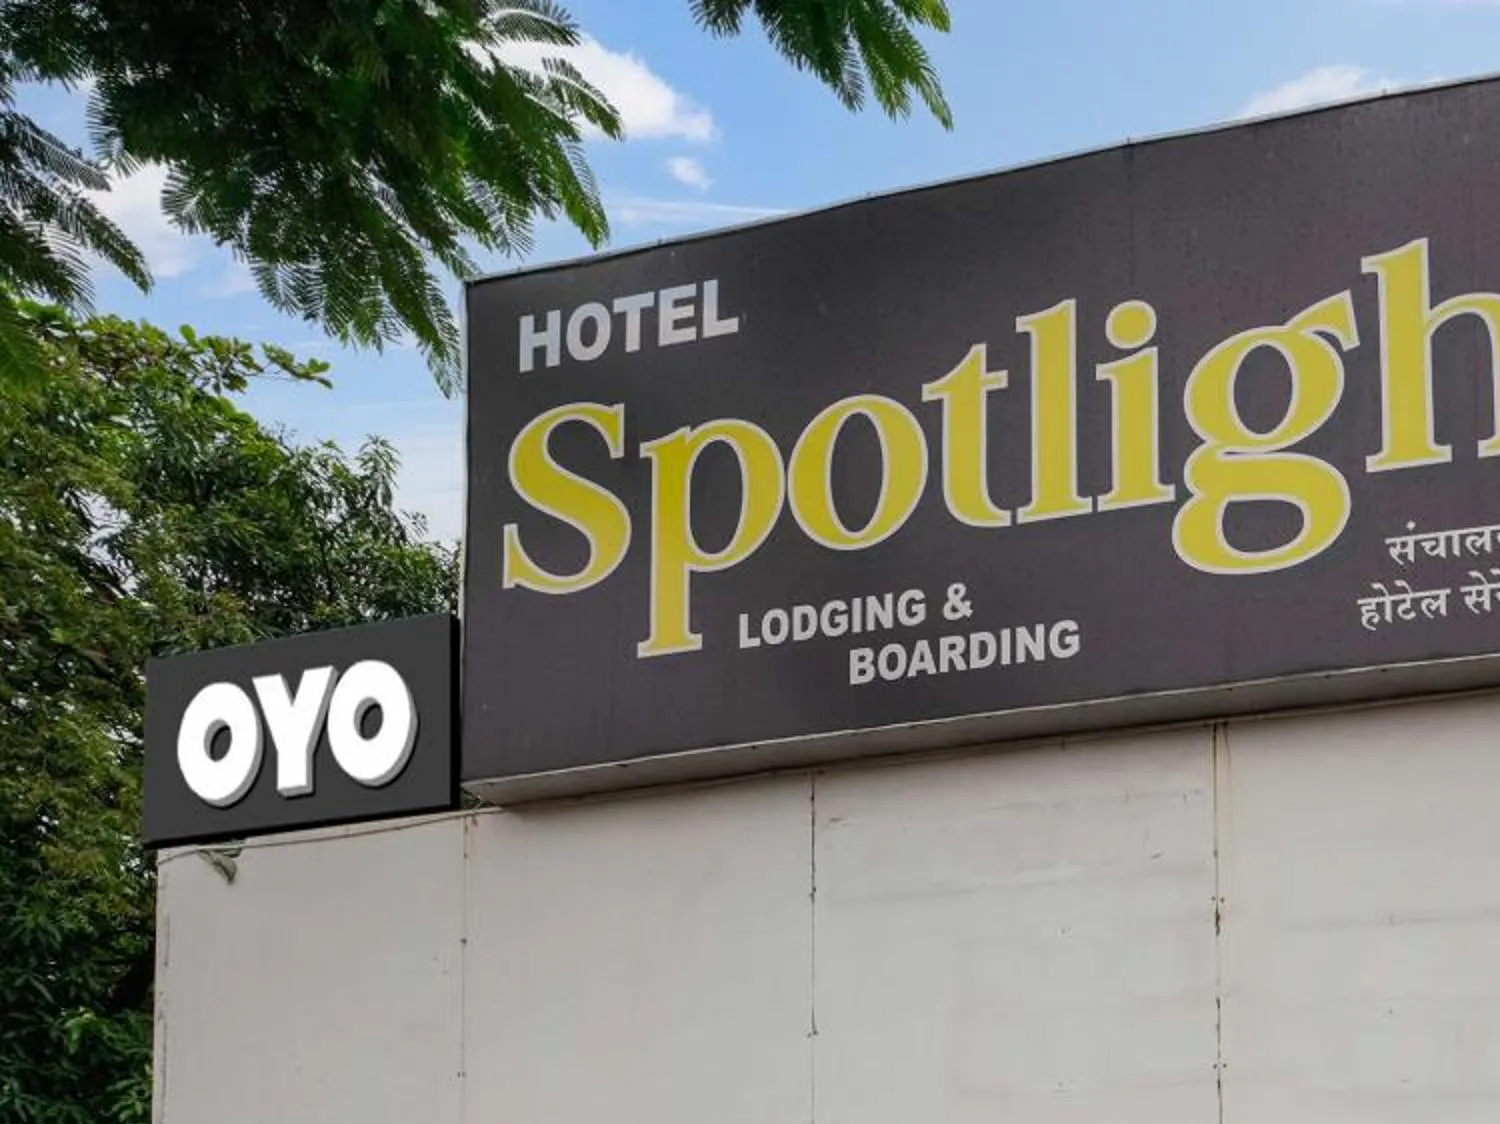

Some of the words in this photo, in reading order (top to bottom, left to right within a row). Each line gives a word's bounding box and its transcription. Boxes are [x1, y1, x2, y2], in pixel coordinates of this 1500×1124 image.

[519, 279, 739, 373] HOTEL
[738, 588, 926, 649] LODGING
[942, 582, 974, 622] &
[1356, 579, 1452, 631] होटेल
[848, 619, 1081, 685] BOARDING
[177, 659, 418, 807] OYO
